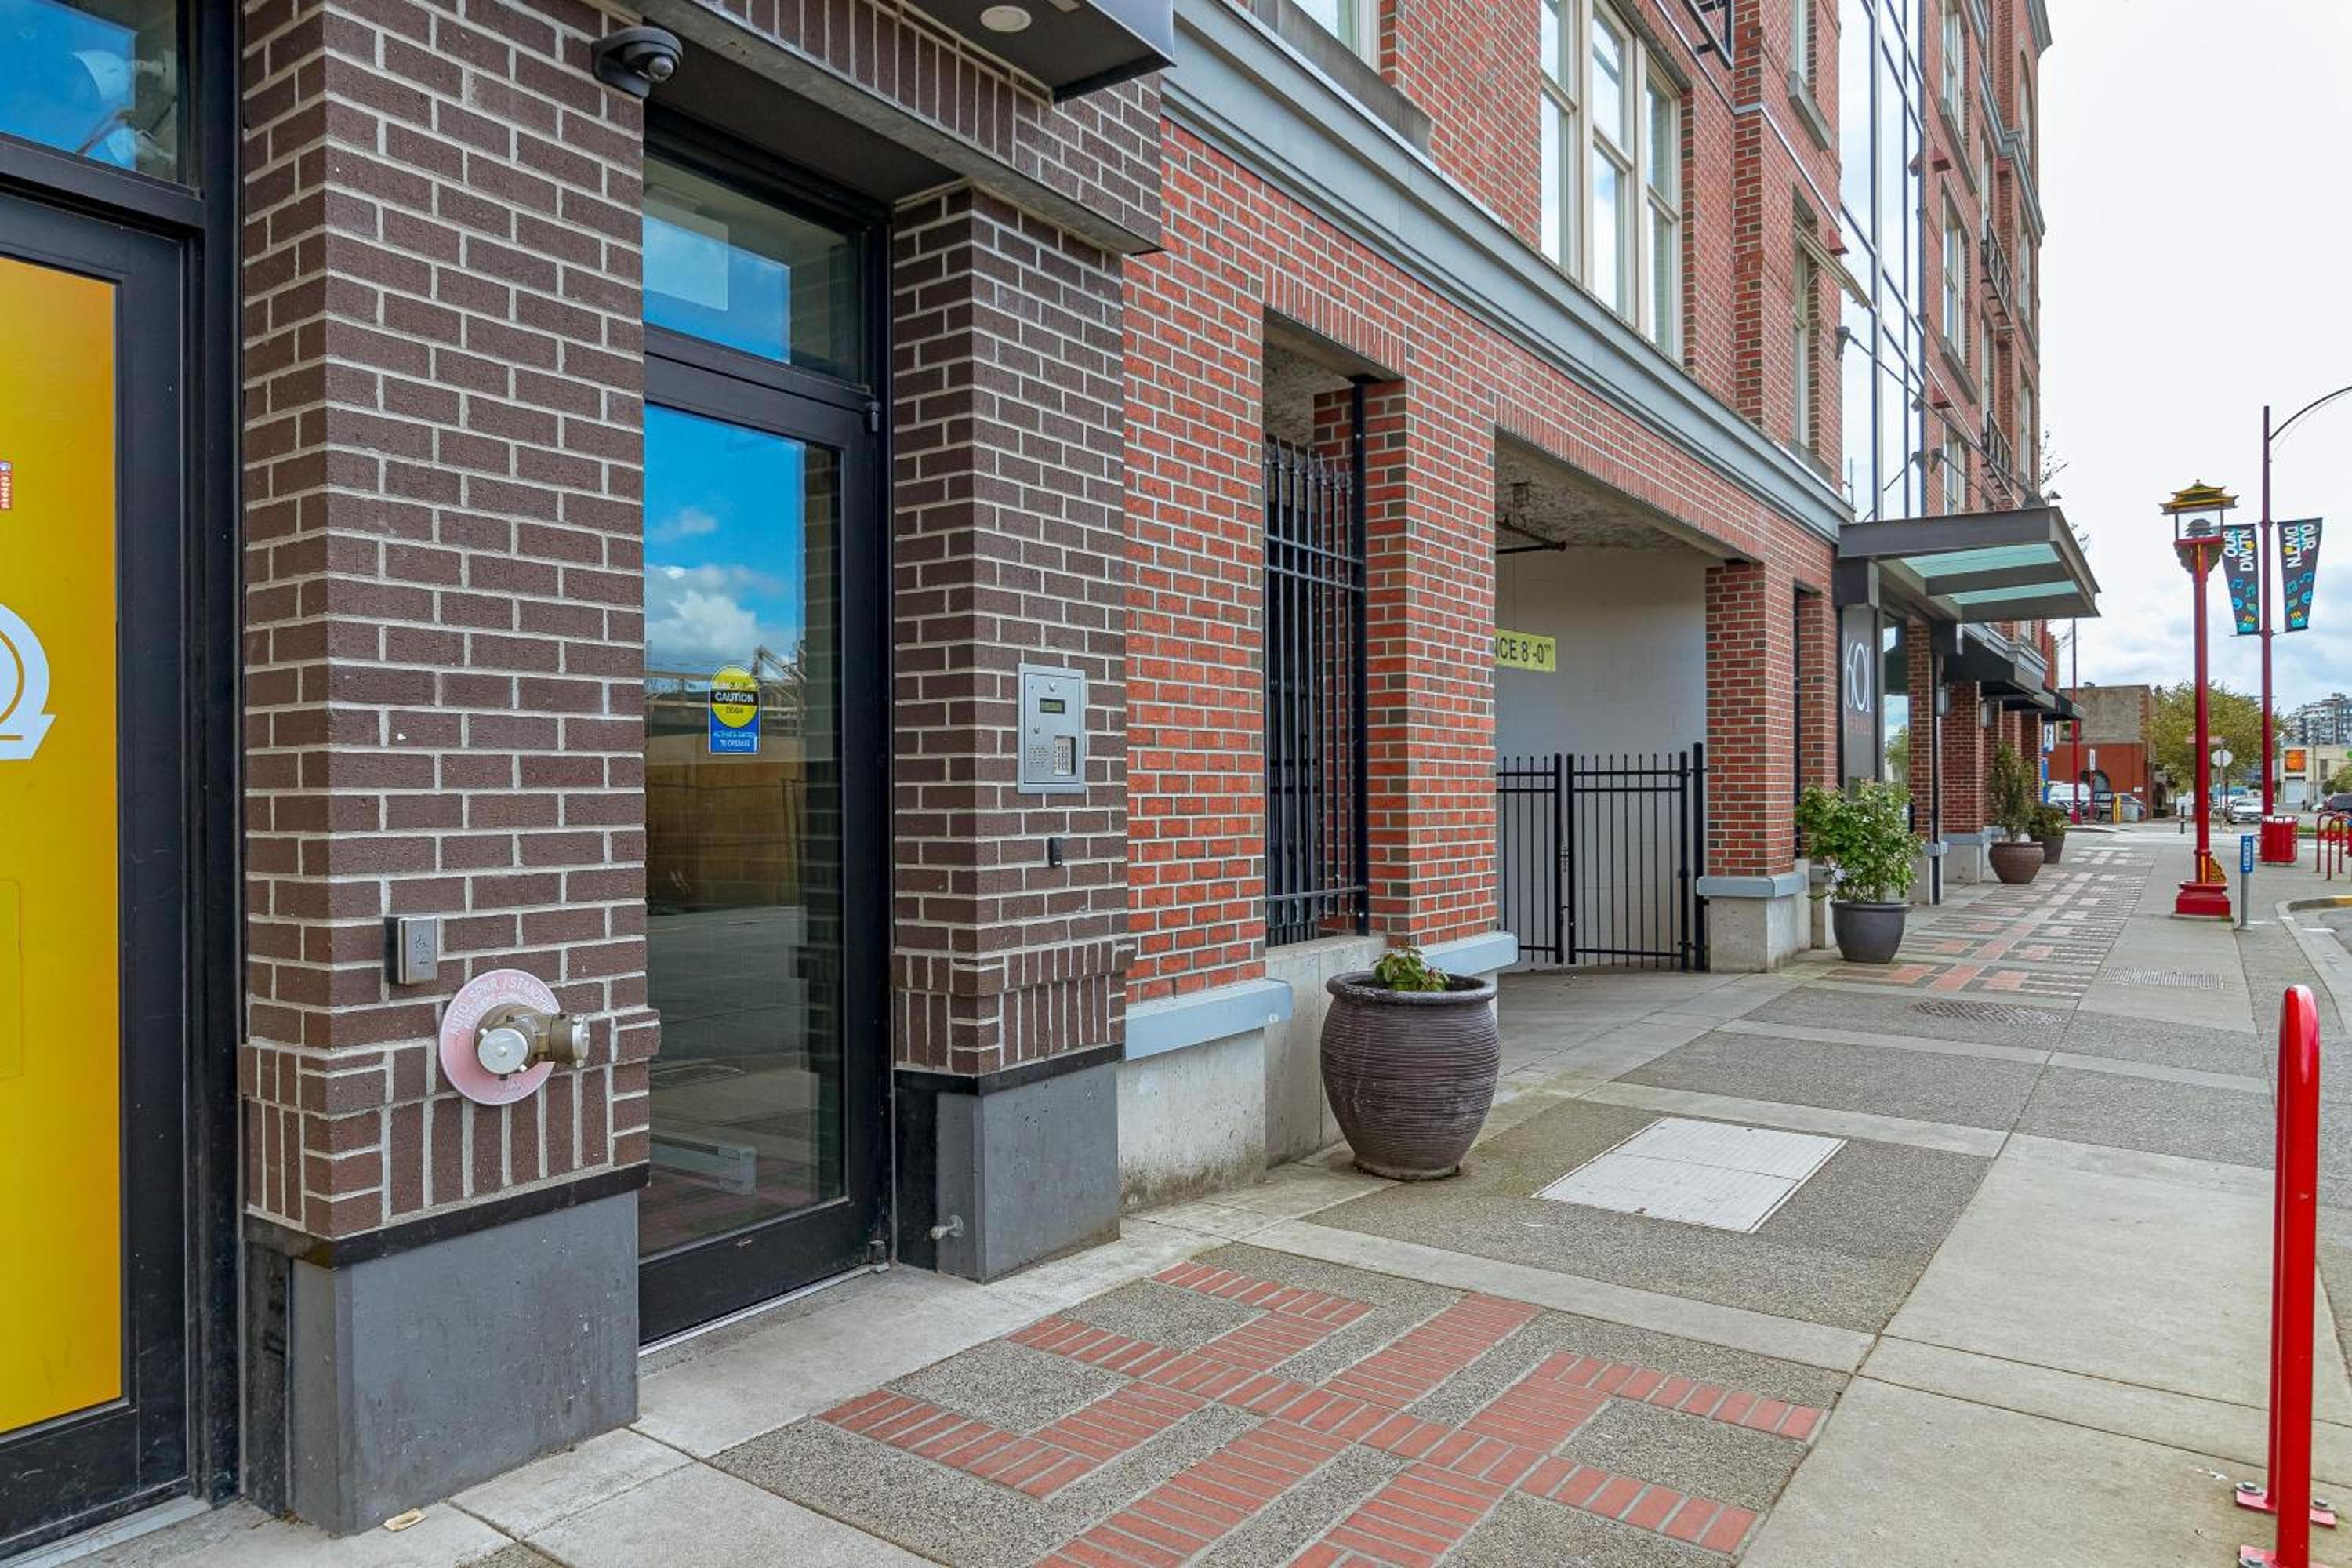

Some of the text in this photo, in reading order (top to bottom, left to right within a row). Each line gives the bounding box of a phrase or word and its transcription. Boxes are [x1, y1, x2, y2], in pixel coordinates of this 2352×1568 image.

[2223, 530, 2238, 557] OUR
[2300, 524, 2317, 552] OUR
[714, 692, 754, 703] CAUTION
[450, 1003, 469, 1036] AUTO
